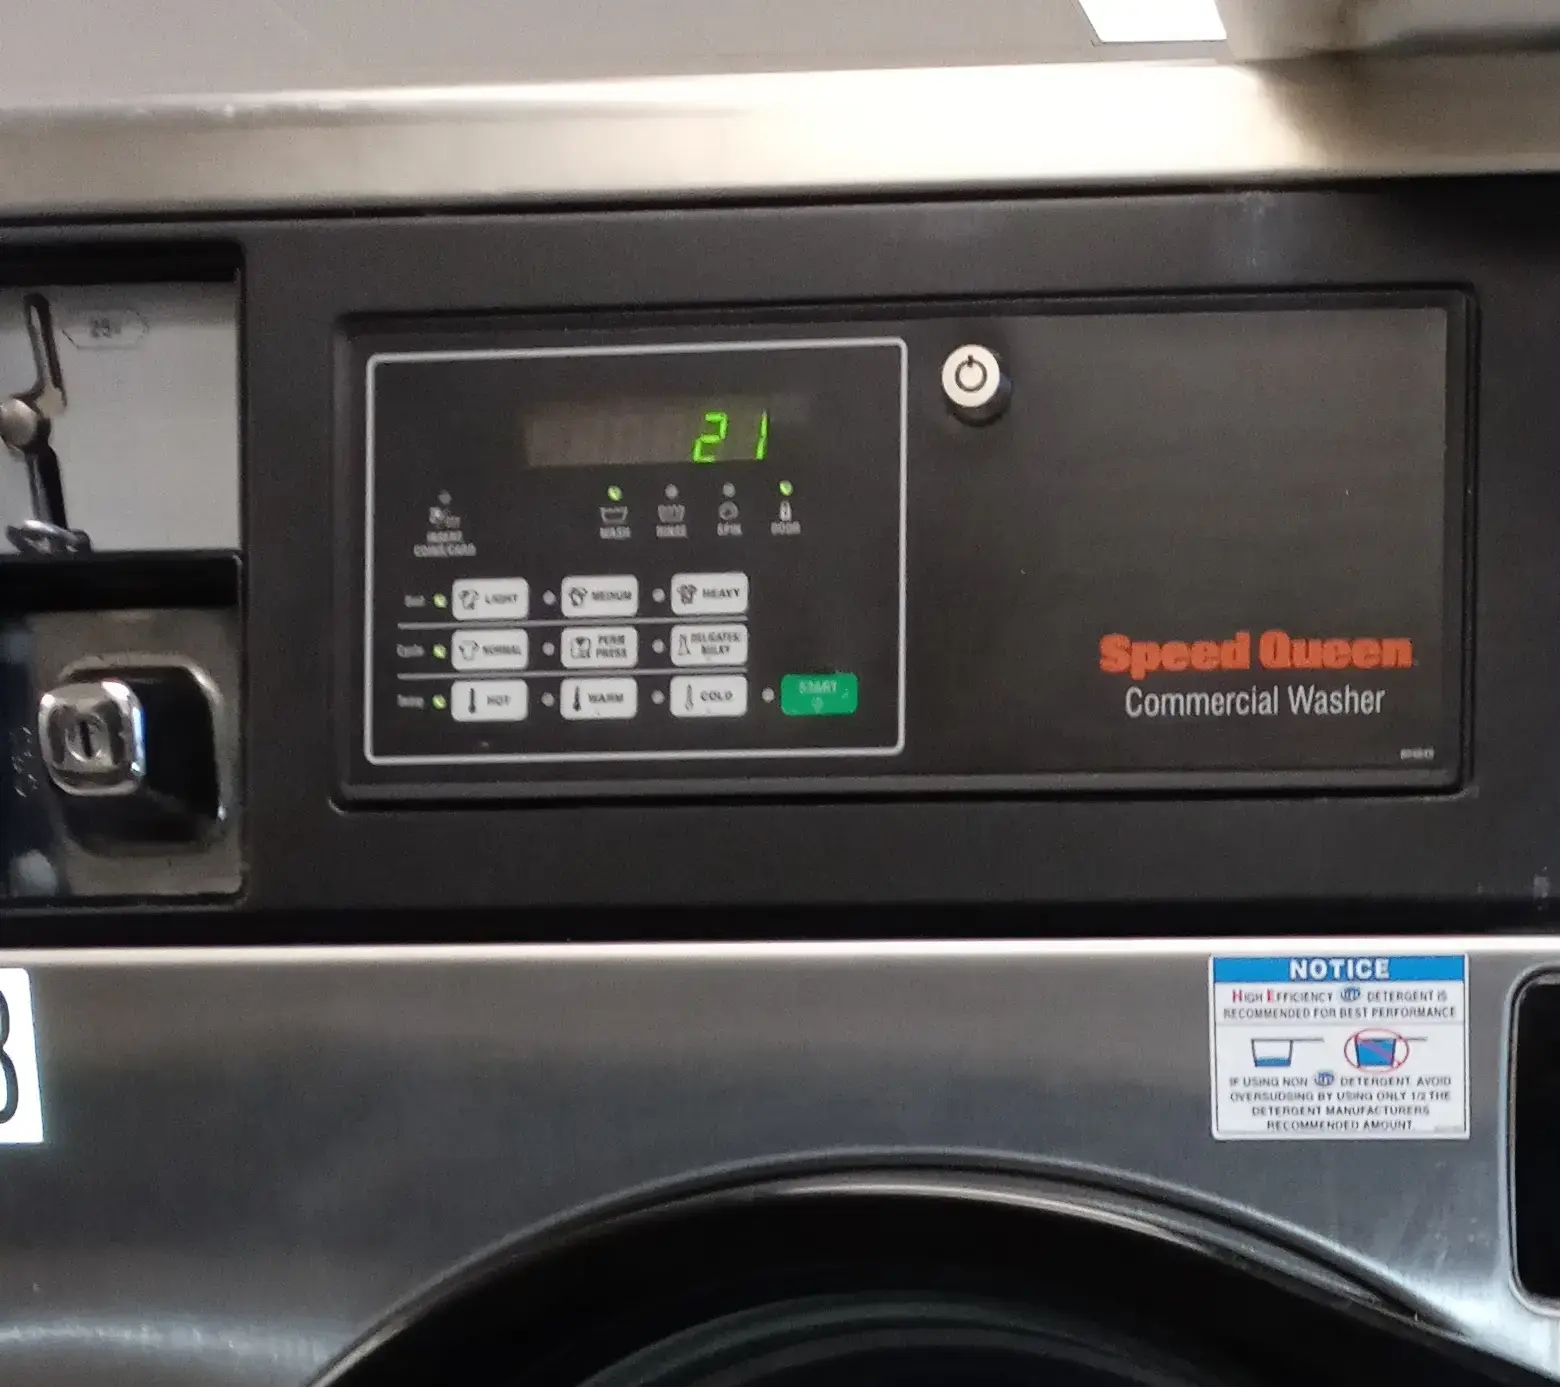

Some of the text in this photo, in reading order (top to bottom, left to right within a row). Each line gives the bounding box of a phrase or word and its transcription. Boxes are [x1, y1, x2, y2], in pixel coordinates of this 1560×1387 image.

[693, 410, 768, 463] 21
[702, 587, 740, 599] HEAVY
[1100, 629, 1413, 680] Speed Queen
[799, 680, 838, 694] START
[487, 695, 511, 706] HOT
[588, 693, 624, 704] WARM
[700, 691, 733, 702] COLD
[1125, 684, 1385, 718] Commercial Washer
[1289, 957, 1391, 981] NOTICE
[1232, 989, 1263, 1003] HIGH
[1267, 988, 1333, 1003] EFFICIENCY
[1367, 989, 1433, 1002] DETERGENT
[1437, 989, 1448, 1002] IS
[1223, 1006, 1456, 1019] RECOMMENDED FOR BEST PERFORMANCE
[1230, 1076, 1239, 1087] IF
[1243, 1076, 1279, 1088] USING
[1283, 1076, 1308, 1087] NON
[1417, 1076, 1452, 1087] AVOID
[1230, 1092, 1314, 1102] OVERSUDSING
[1318, 1091, 1332, 1101] BY
[1337, 1091, 1373, 1101] USING
[1377, 1090, 1406, 1101] ONLY
[1429, 1090, 1450, 1101] THE
[1252, 1105, 1321, 1116] DETERGENT
[1267, 1120, 1359, 1131] RECOMMENDED
